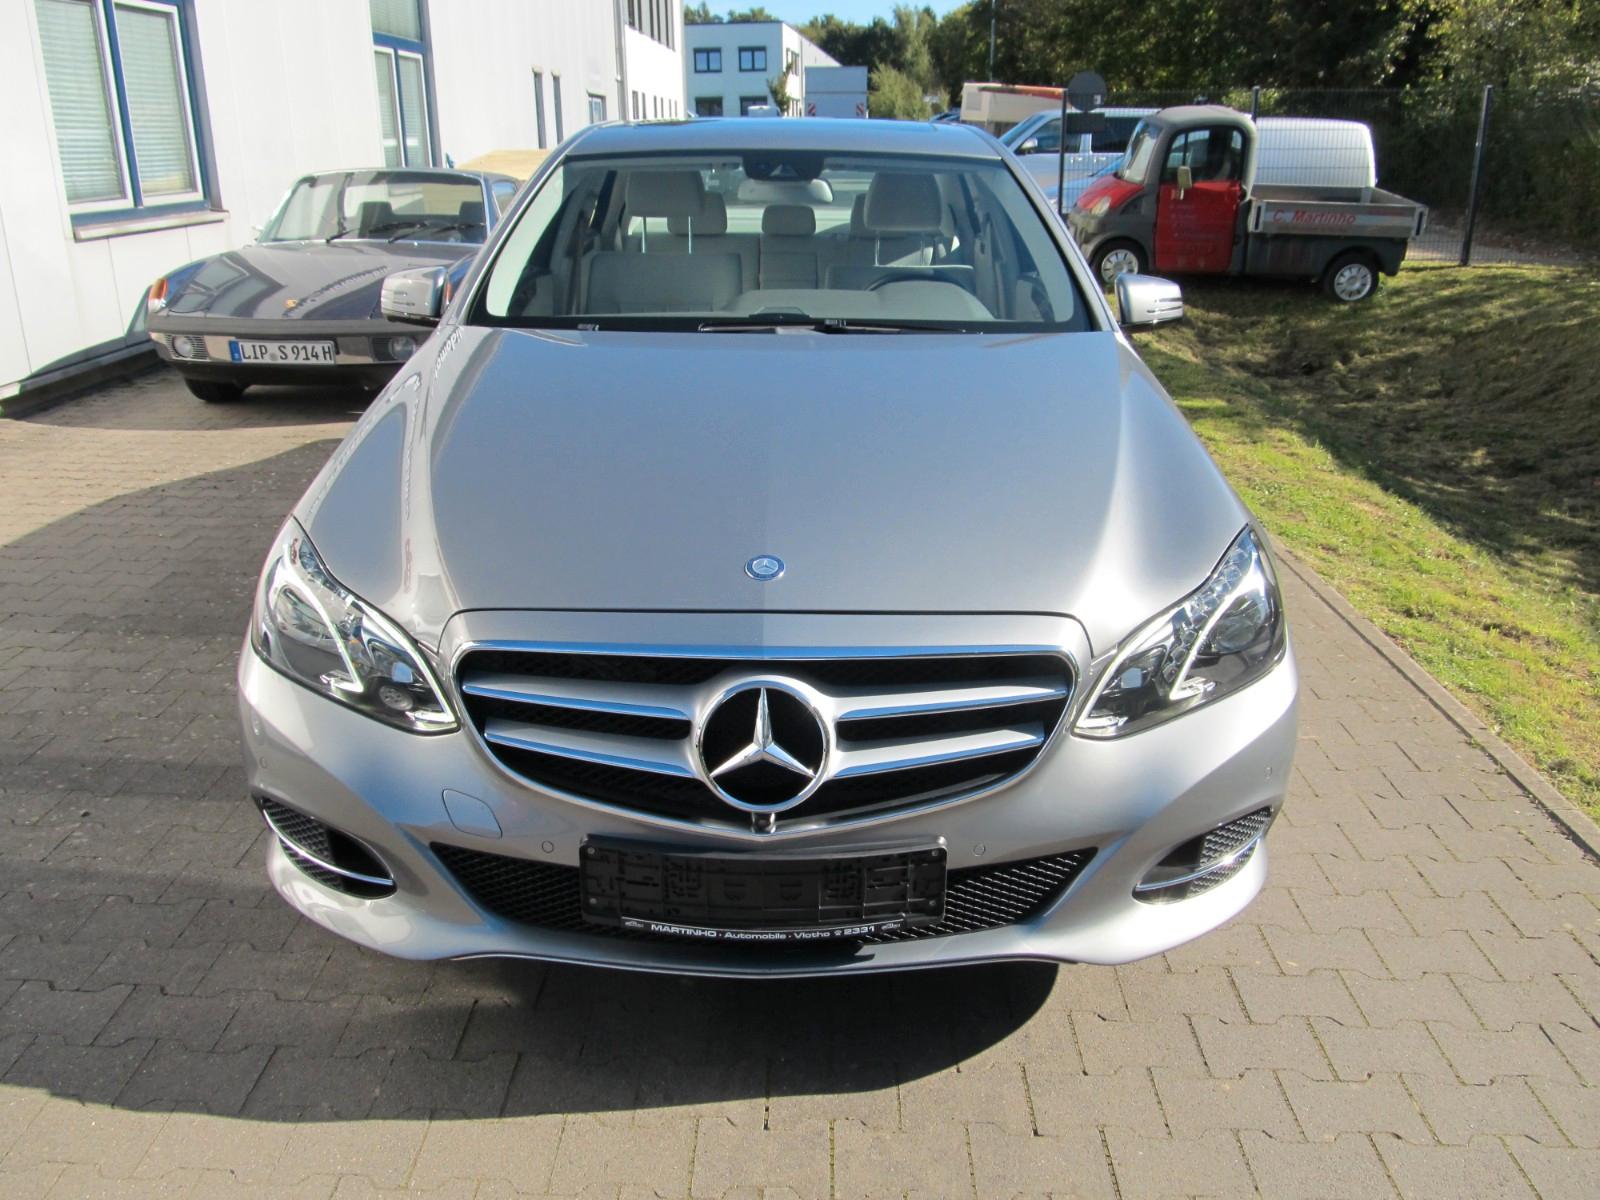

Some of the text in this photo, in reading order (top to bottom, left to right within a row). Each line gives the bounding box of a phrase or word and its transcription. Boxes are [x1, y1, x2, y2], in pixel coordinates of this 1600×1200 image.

[1292, 209, 1356, 225] Martinho
[240, 344, 268, 360] LIP
[291, 345, 319, 361] 914
[322, 345, 333, 361] H
[651, 924, 717, 938] MARTINHO
[724, 931, 786, 940] Automobile
[793, 931, 830, 939] Vlotho
[843, 926, 875, 936] 2331
